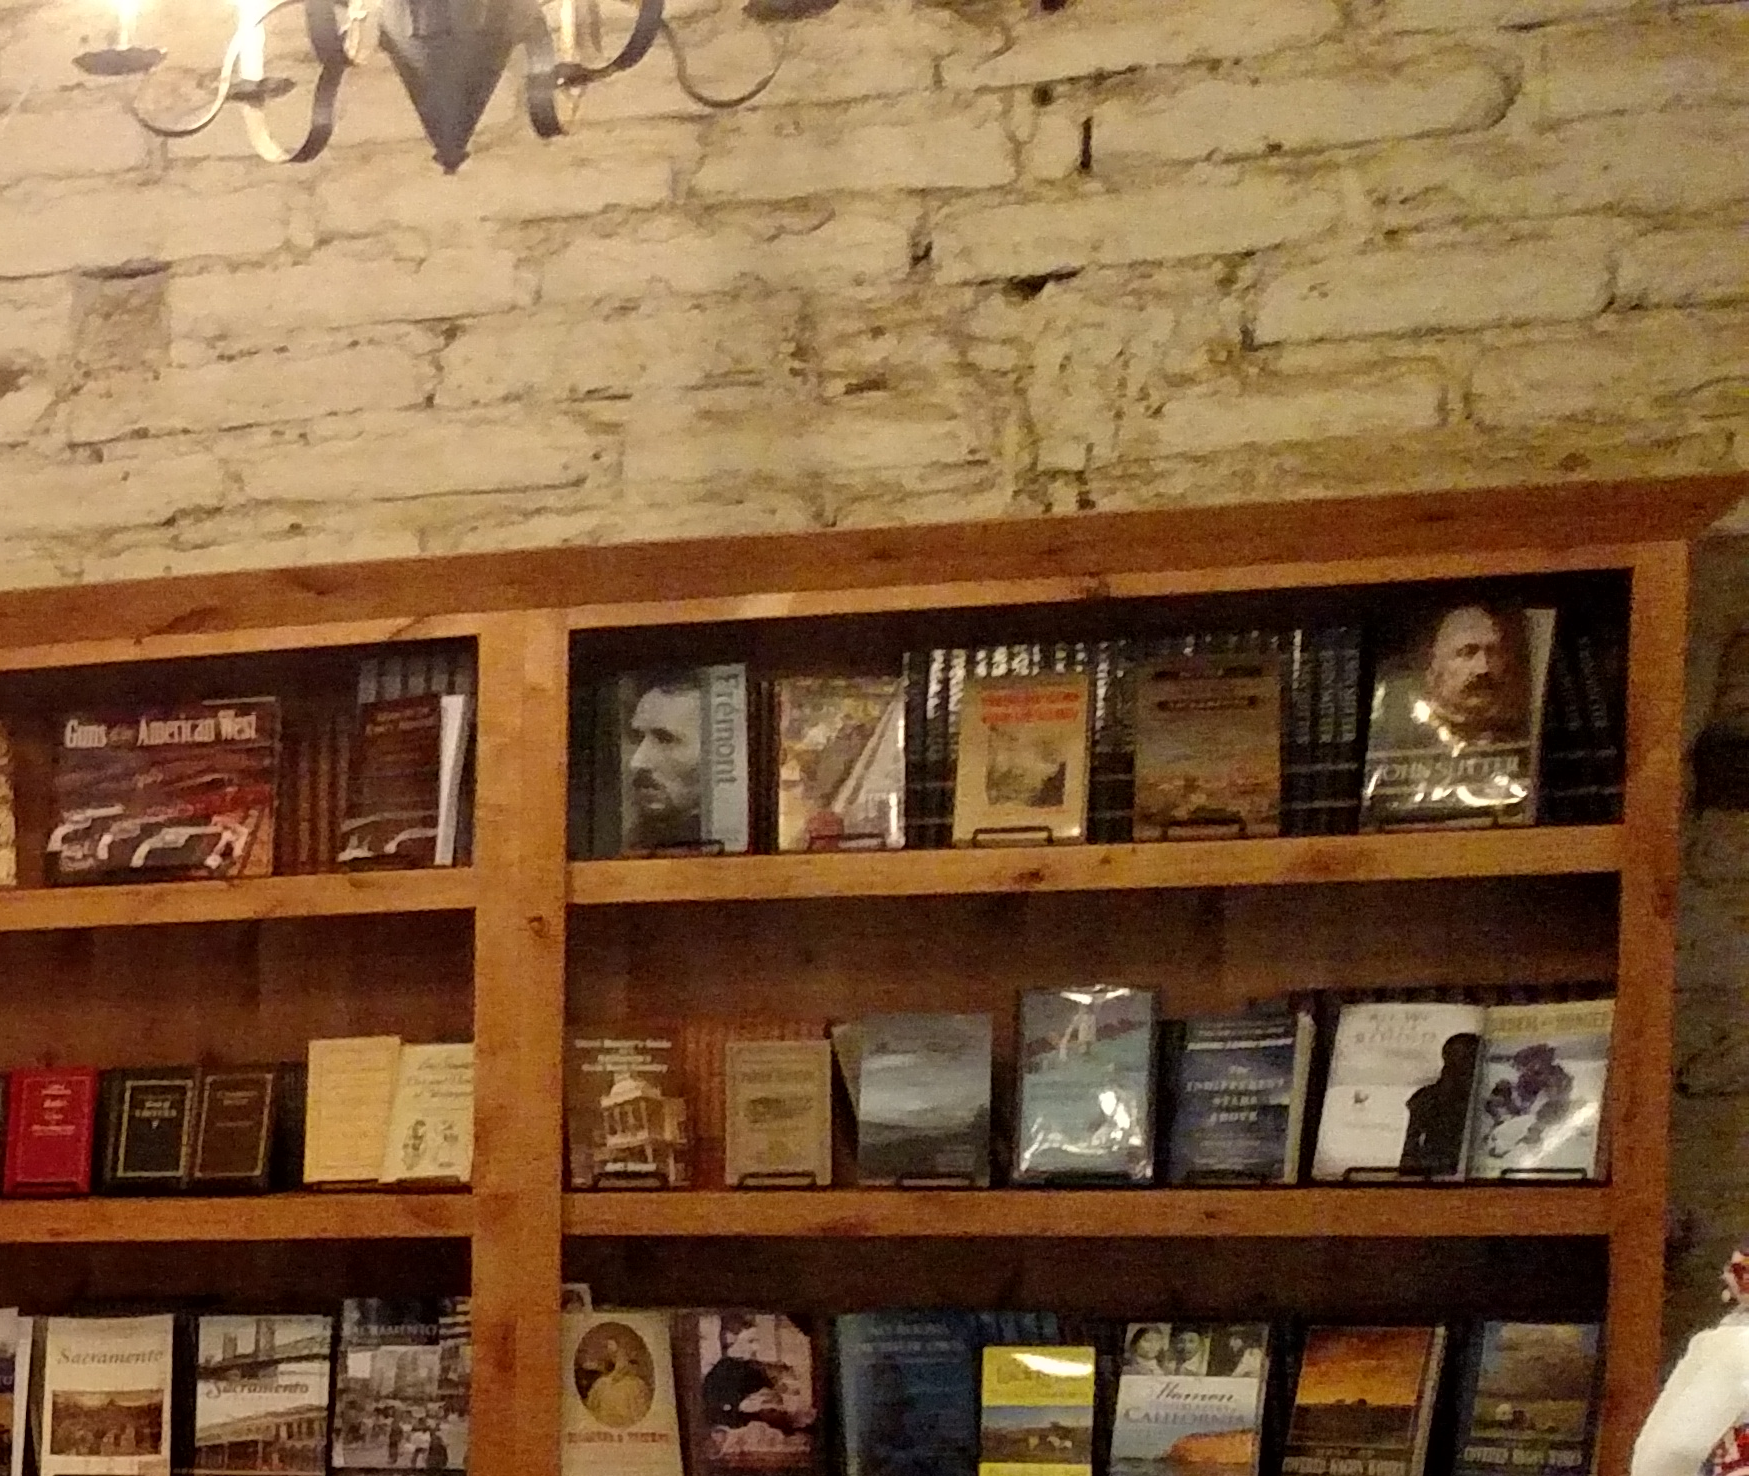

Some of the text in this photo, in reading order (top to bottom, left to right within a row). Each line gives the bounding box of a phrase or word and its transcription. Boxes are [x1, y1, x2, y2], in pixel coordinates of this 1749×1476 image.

[64, 718, 108, 748] Guns
[136, 713, 216, 746] American
[217, 709, 257, 742] West
[57, 1348, 164, 1364] Sacramento
[205, 1380, 309, 1399] Sacramento
